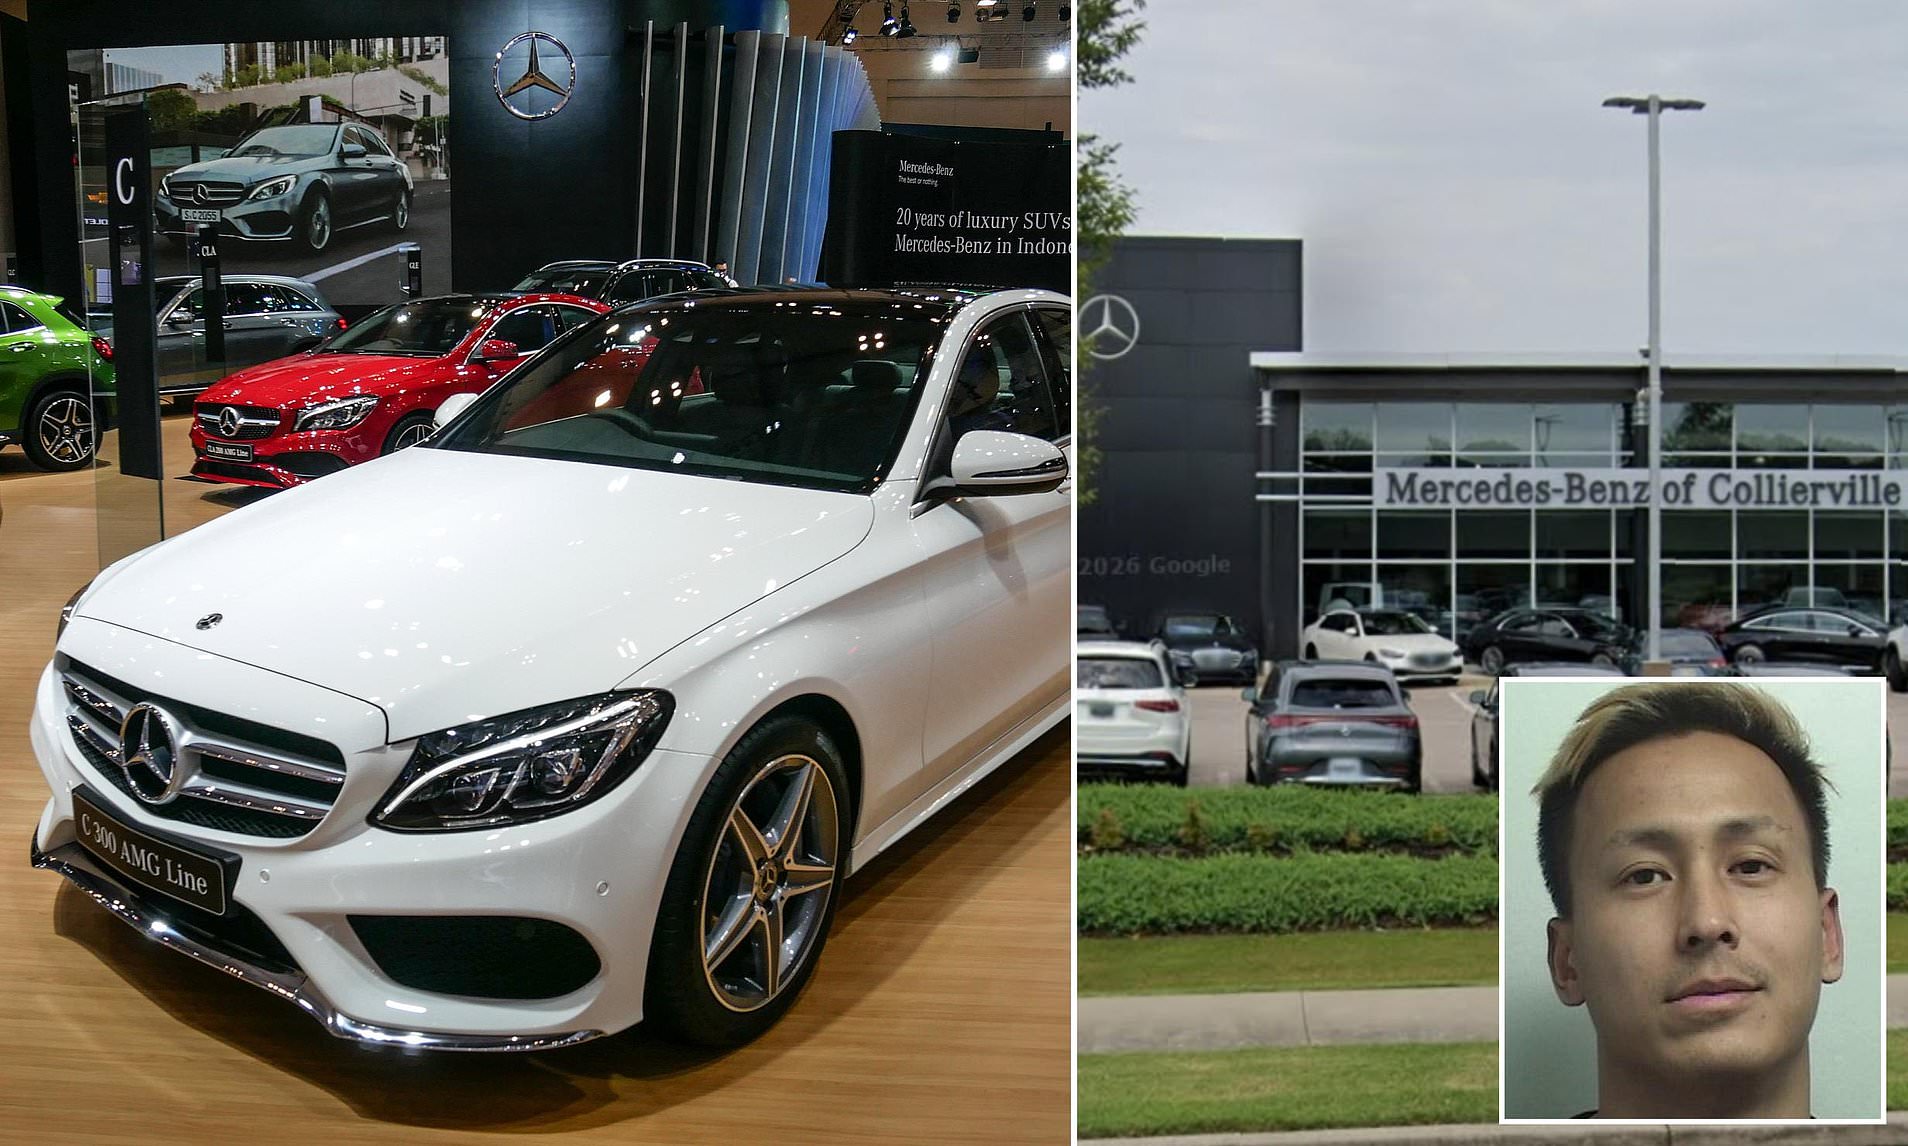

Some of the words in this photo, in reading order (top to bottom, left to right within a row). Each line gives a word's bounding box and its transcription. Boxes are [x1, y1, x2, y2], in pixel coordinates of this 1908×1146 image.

[898, 175, 906, 184] The
[899, 160, 954, 176] Mercedes-Benz
[116, 157, 135, 204] C
[896, 207, 911, 226] 20
[914, 212, 945, 231] years
[949, 210, 965, 228] of
[966, 211, 1019, 234] luxury
[1023, 212, 1071, 230] SUVs
[201, 246, 216, 256] CLA
[894, 233, 992, 254] Mercedes-Benz
[996, 237, 1012, 254] in
[1386, 472, 1650, 505] Mercedes-Benz
[1662, 473, 1697, 505] of
[1708, 473, 1901, 505] Collierville
[81, 813, 91, 836] C
[93, 822, 117, 853] 300
[120, 841, 161, 877] AMG
[165, 858, 208, 895] Line
